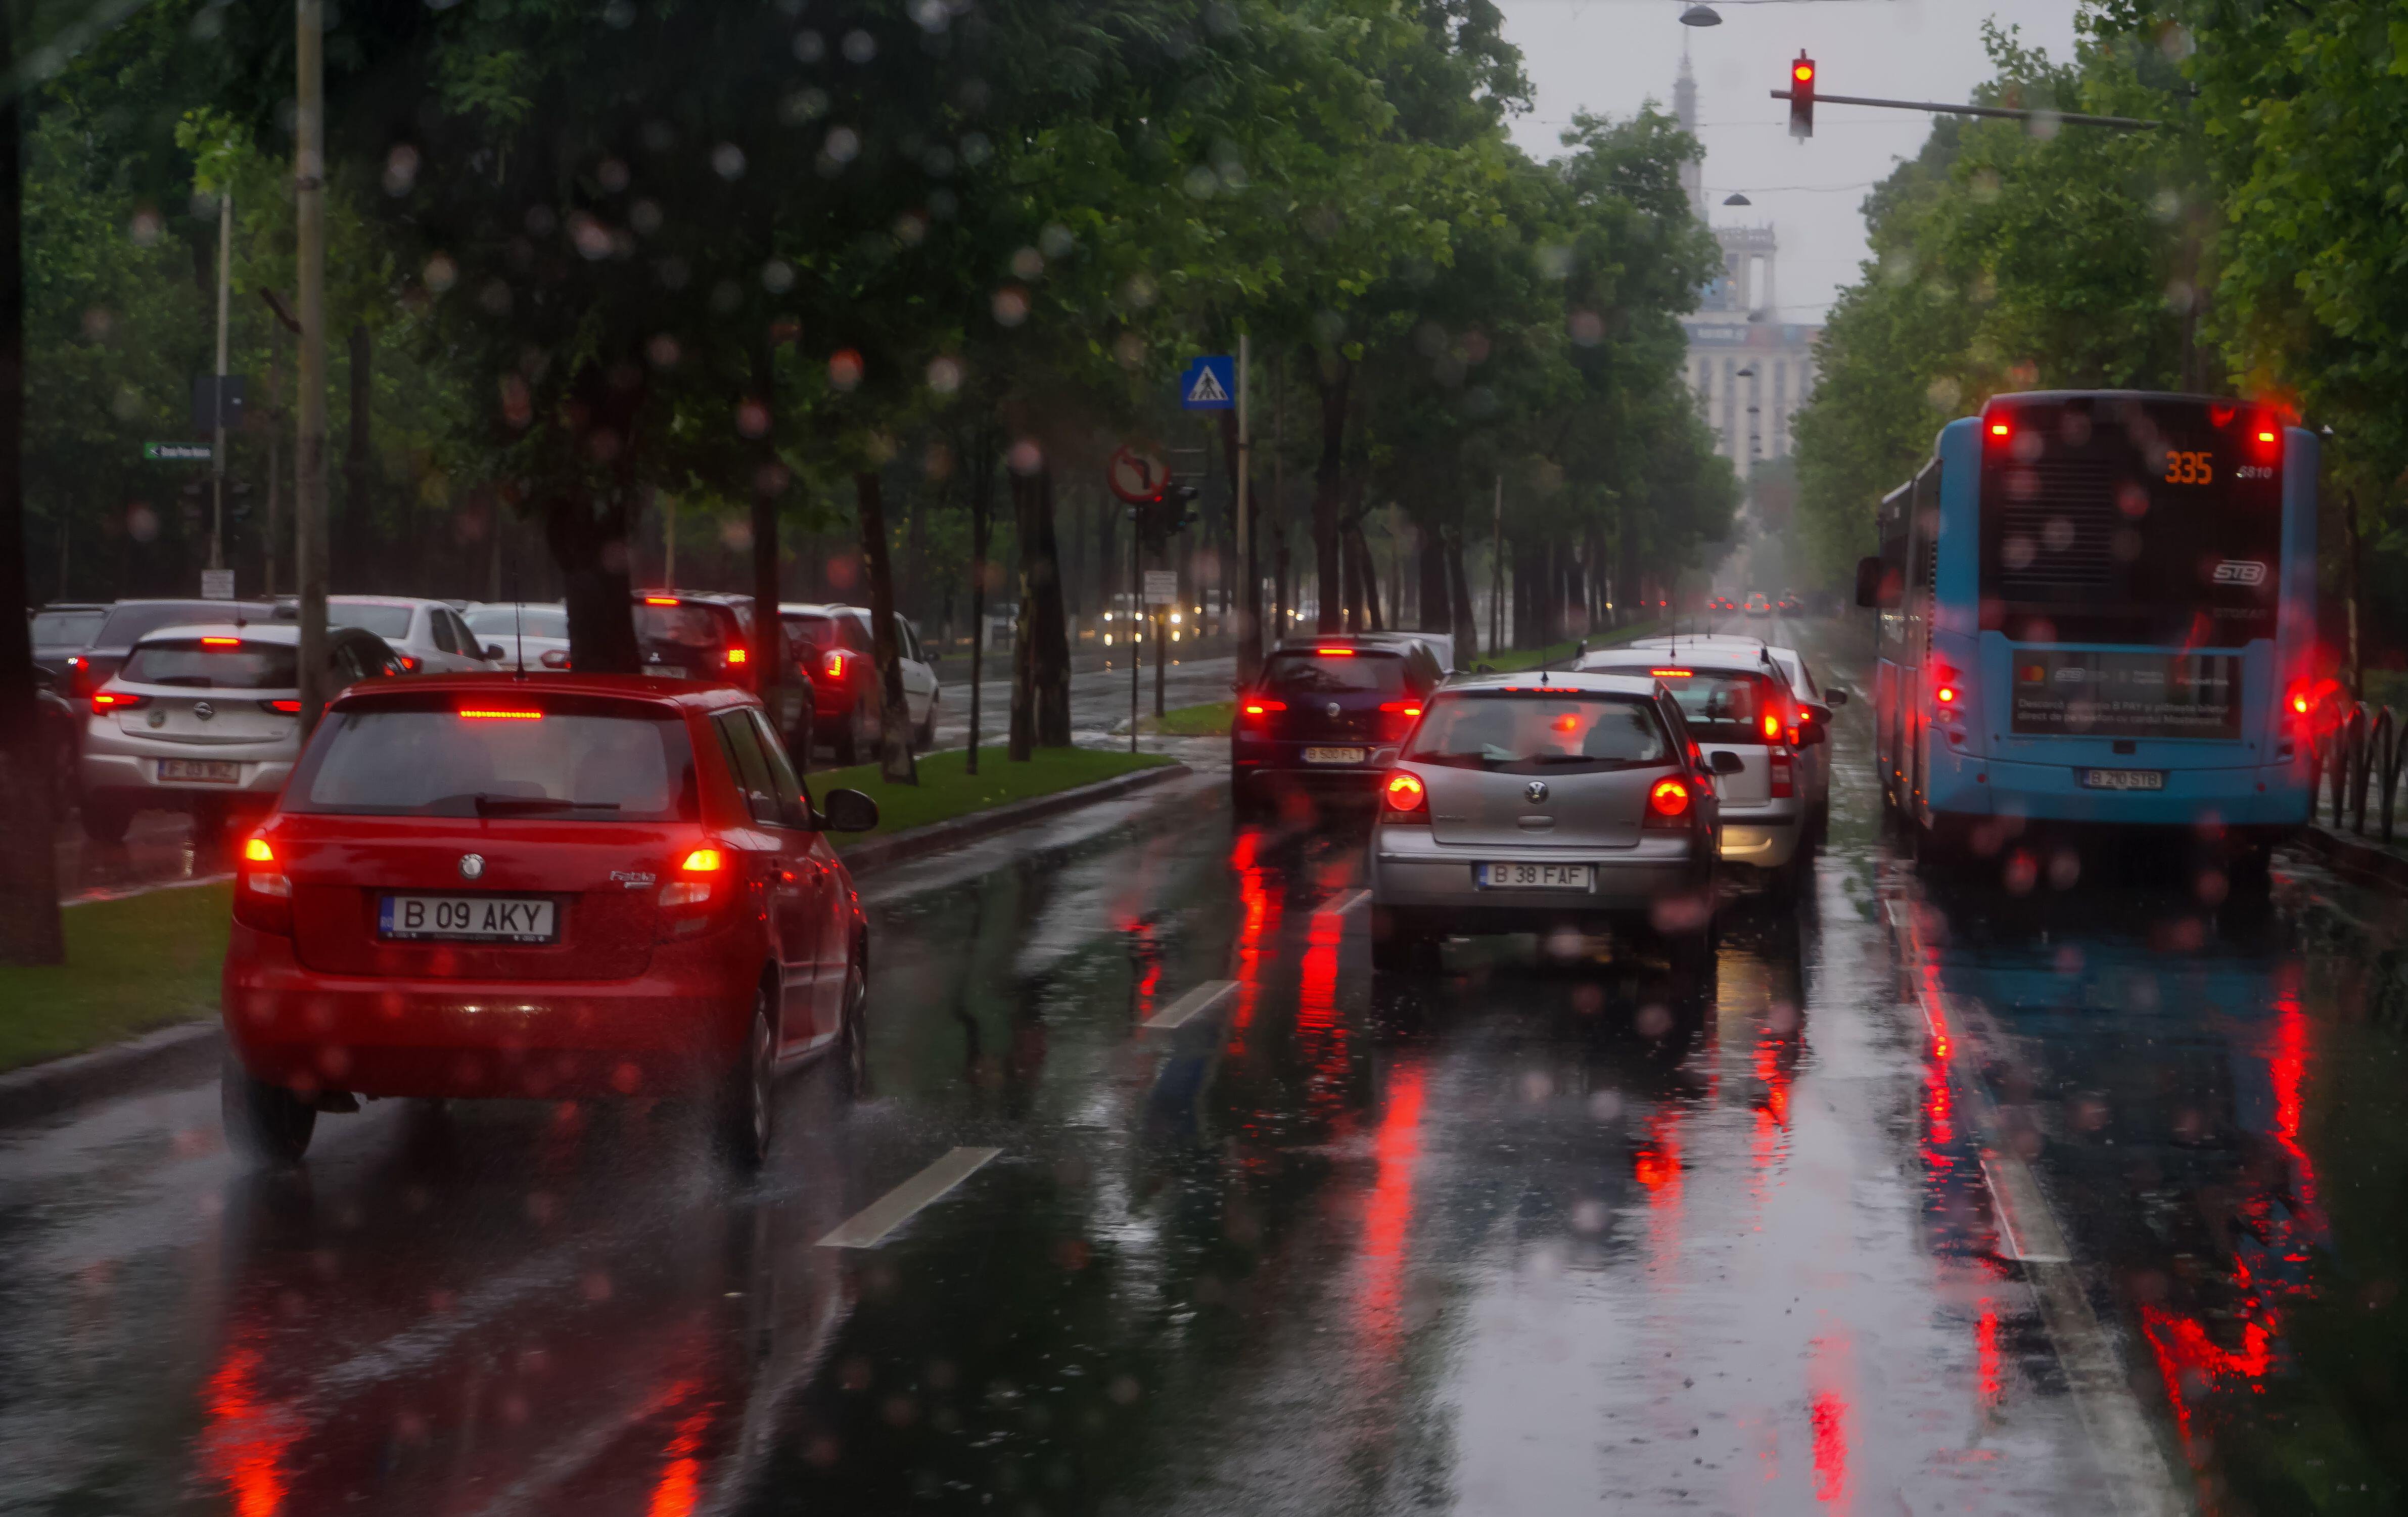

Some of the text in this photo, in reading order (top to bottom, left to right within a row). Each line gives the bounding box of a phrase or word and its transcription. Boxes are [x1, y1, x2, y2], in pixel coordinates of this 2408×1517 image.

[2165, 450, 2212, 484] 335
[2213, 563, 2262, 581] STB
[1495, 864, 1581, 884] B 38 FAF
[405, 901, 541, 932] B 09 AKY
